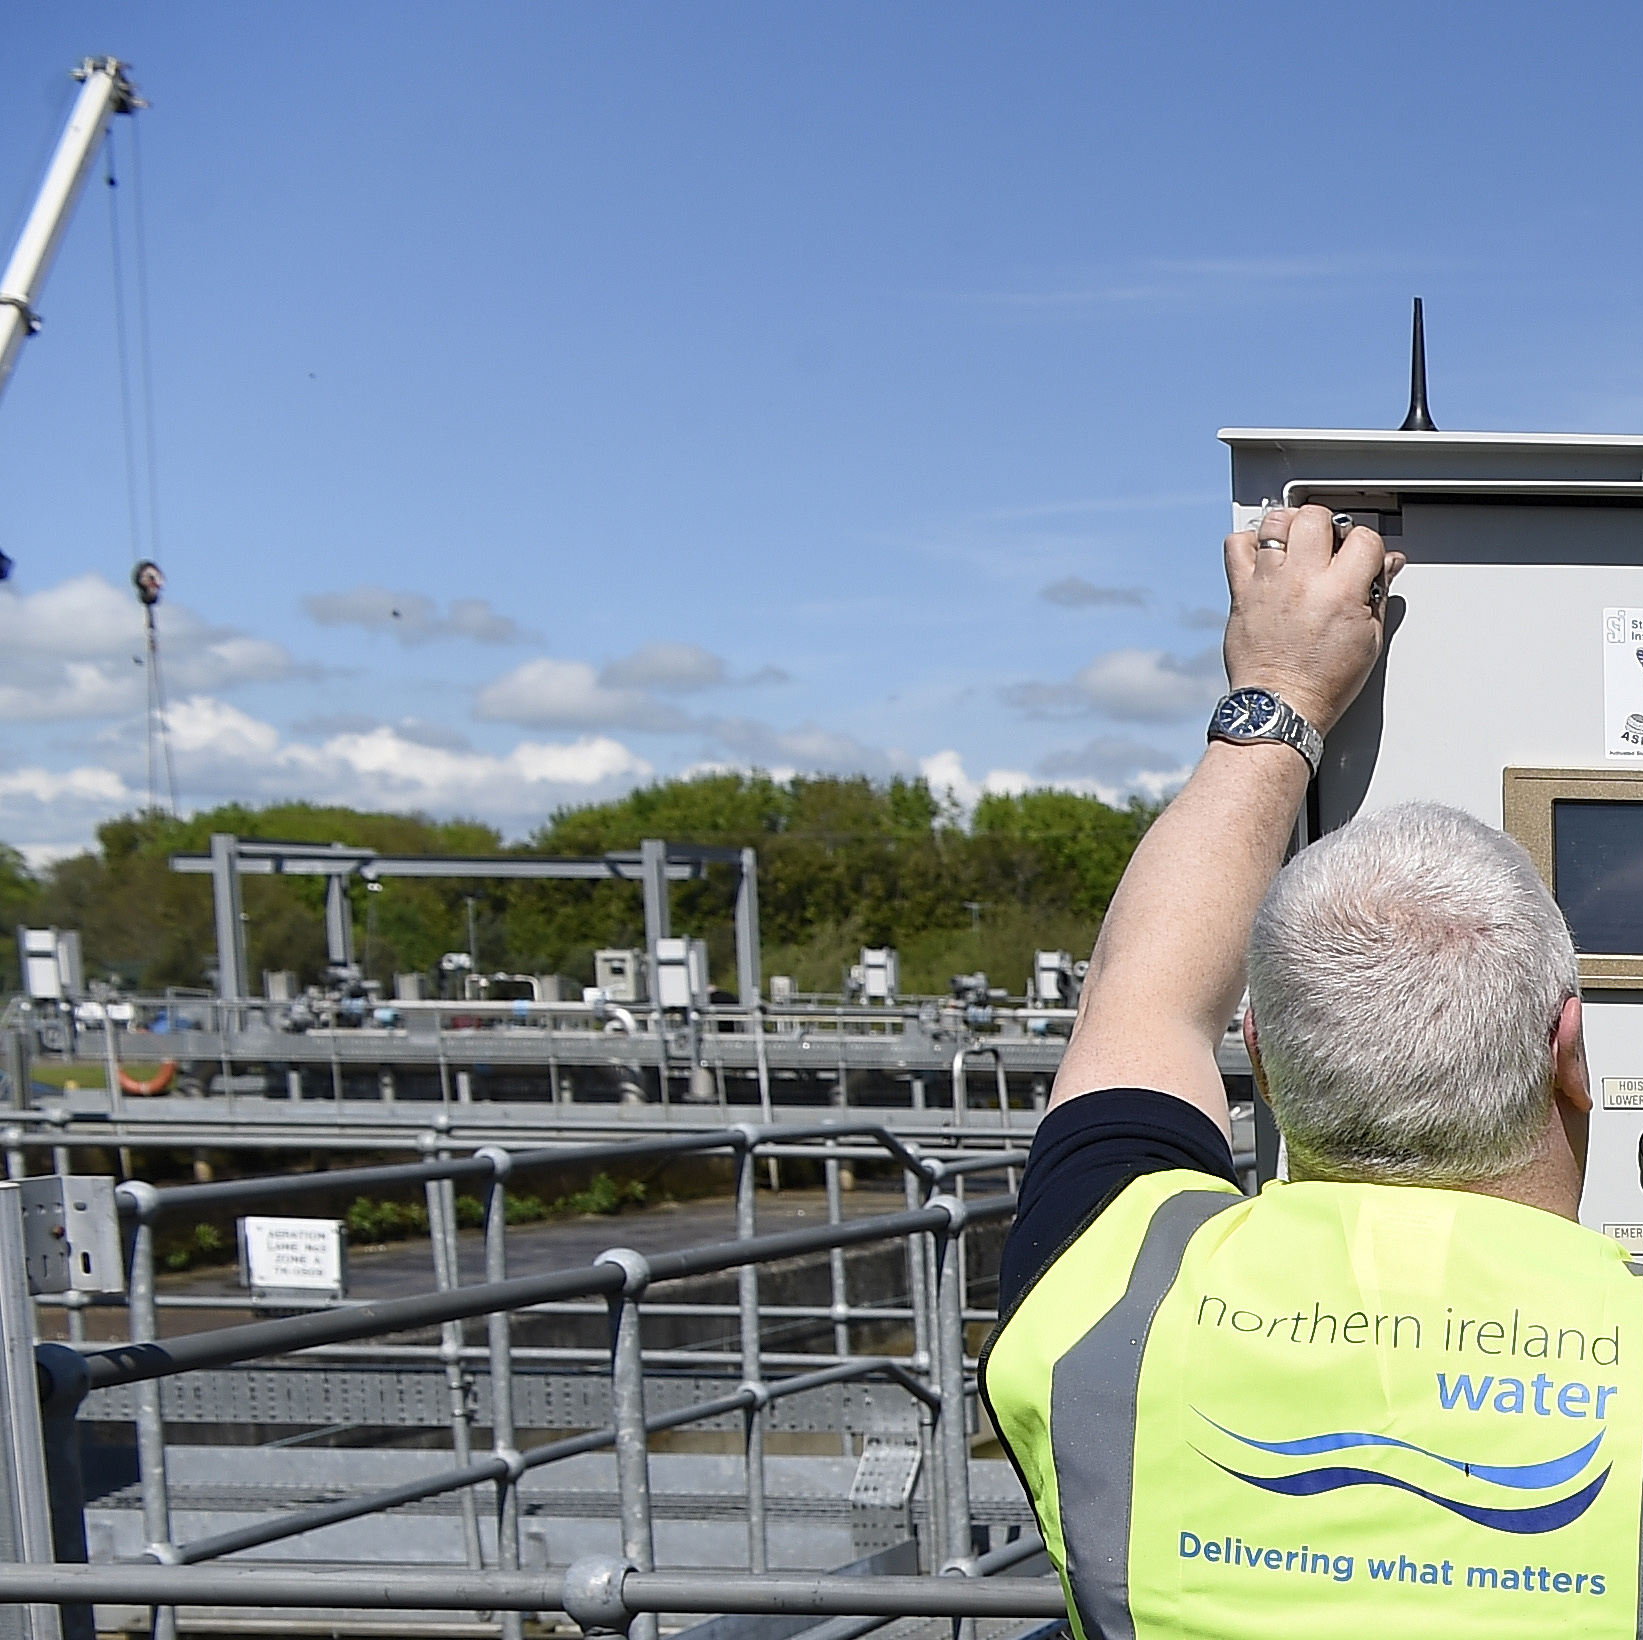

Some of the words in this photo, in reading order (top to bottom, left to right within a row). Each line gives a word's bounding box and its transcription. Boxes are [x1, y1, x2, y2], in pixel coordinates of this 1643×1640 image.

[1196, 1293, 1422, 1350] northern
[1444, 1307, 1620, 1366] ireland
[1435, 1372, 1618, 1420] water
[1179, 1531, 1354, 1582] Delivering
[1368, 1553, 1454, 1586] what
[1466, 1563, 1607, 1596] matters
